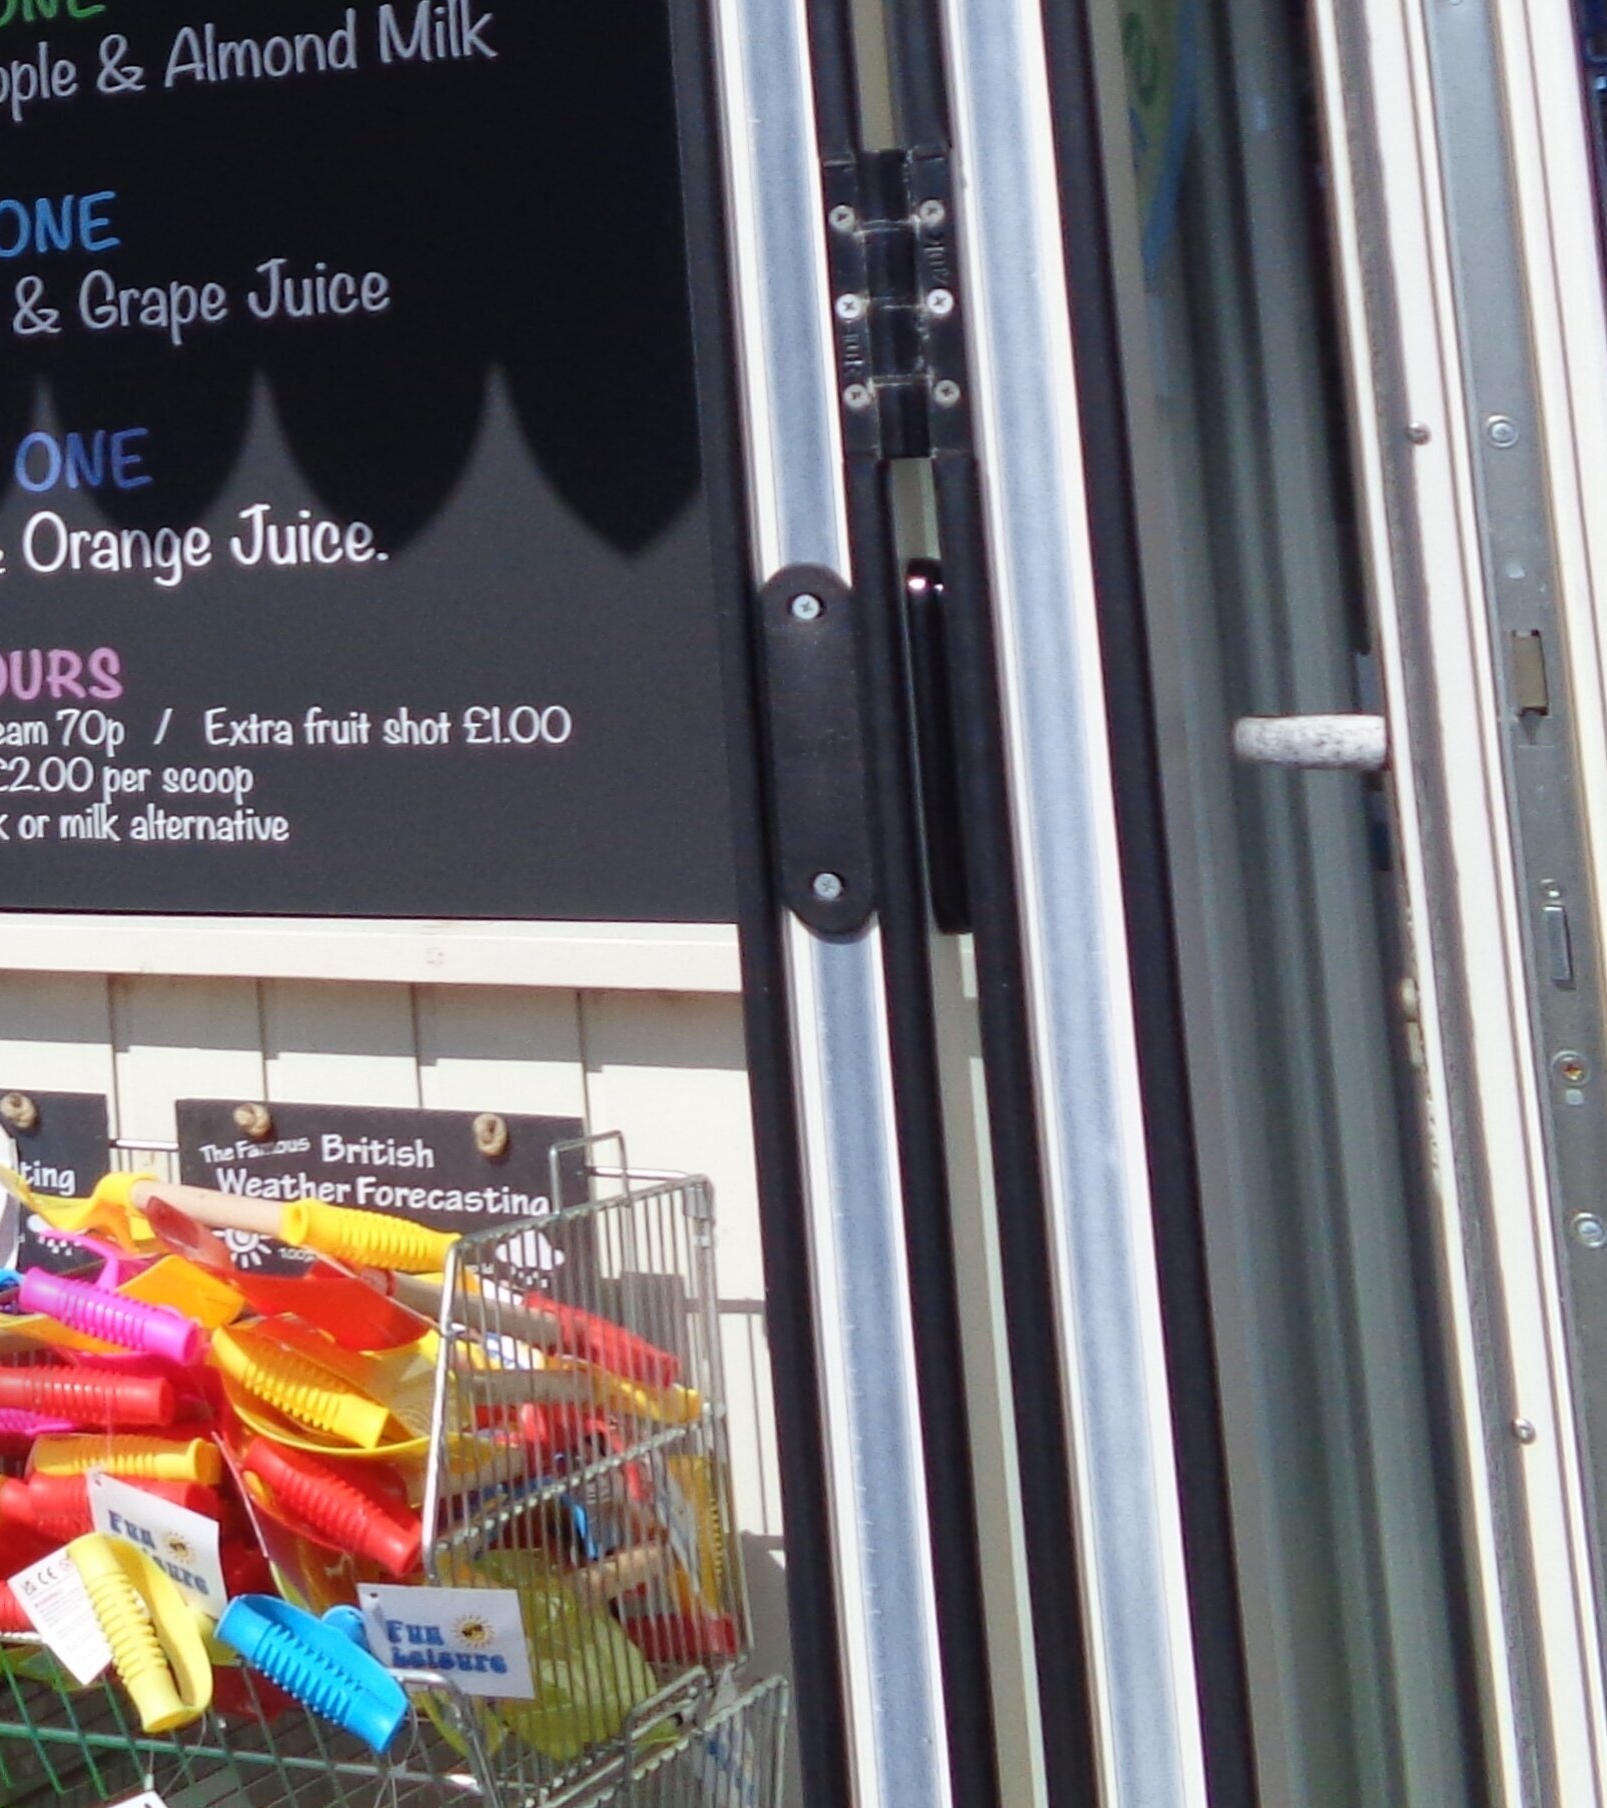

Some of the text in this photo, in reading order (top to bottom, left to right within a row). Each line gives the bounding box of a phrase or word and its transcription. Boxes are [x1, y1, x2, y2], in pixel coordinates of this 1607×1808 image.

[96, 33, 147, 95] &
[164, 7, 358, 89] Almond
[12, 275, 62, 336] &
[78, 269, 228, 346] Grape
[247, 257, 391, 319] Juice
[14, 427, 152, 496] ONE
[21, 510, 213, 587] Orange
[229, 503, 389, 566] Juice.
[55, 707, 125, 758] 70p
[152, 707, 174, 746] /
[204, 706, 294, 747] Extra
[302, 706, 372, 745] fruit
[382, 706, 452, 746] shot
[461, 705, 572, 744] £1.00
[102, 765, 150, 804] per
[161, 765, 254, 806] scoop
[17, 814, 51, 840] or
[60, 802, 120, 841] milk
[129, 802, 290, 843] alternative
[199, 1145, 234, 1163] The
[321, 1134, 434, 1169] British
[216, 1167, 551, 1217] Weather Forecasting
[387, 1619, 446, 1646] Fun
[390, 1651, 508, 1674] Leisure
